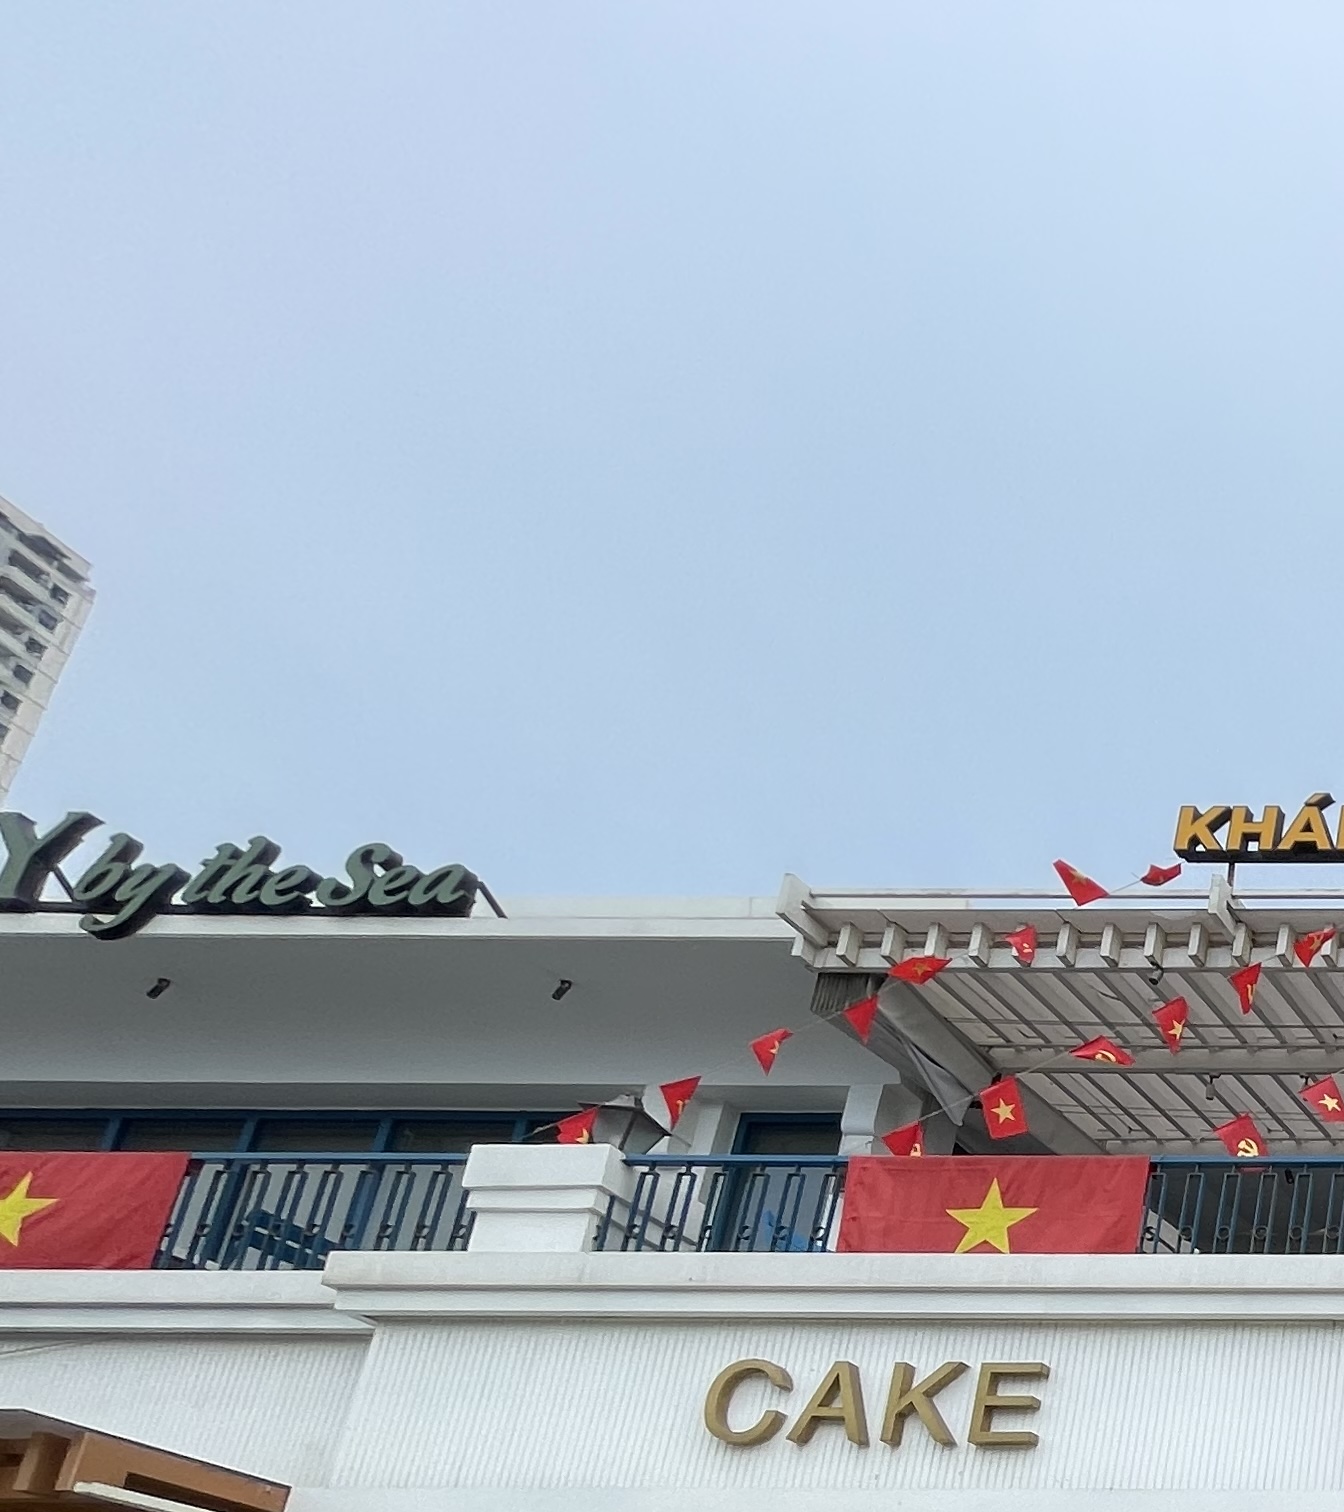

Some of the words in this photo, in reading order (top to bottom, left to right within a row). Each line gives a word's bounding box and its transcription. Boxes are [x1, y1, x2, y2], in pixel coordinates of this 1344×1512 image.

[73, 833, 191, 940] by
[182, 835, 323, 912] the
[316, 842, 483, 917] Sea
[704, 1357, 1050, 1448] CAKE
